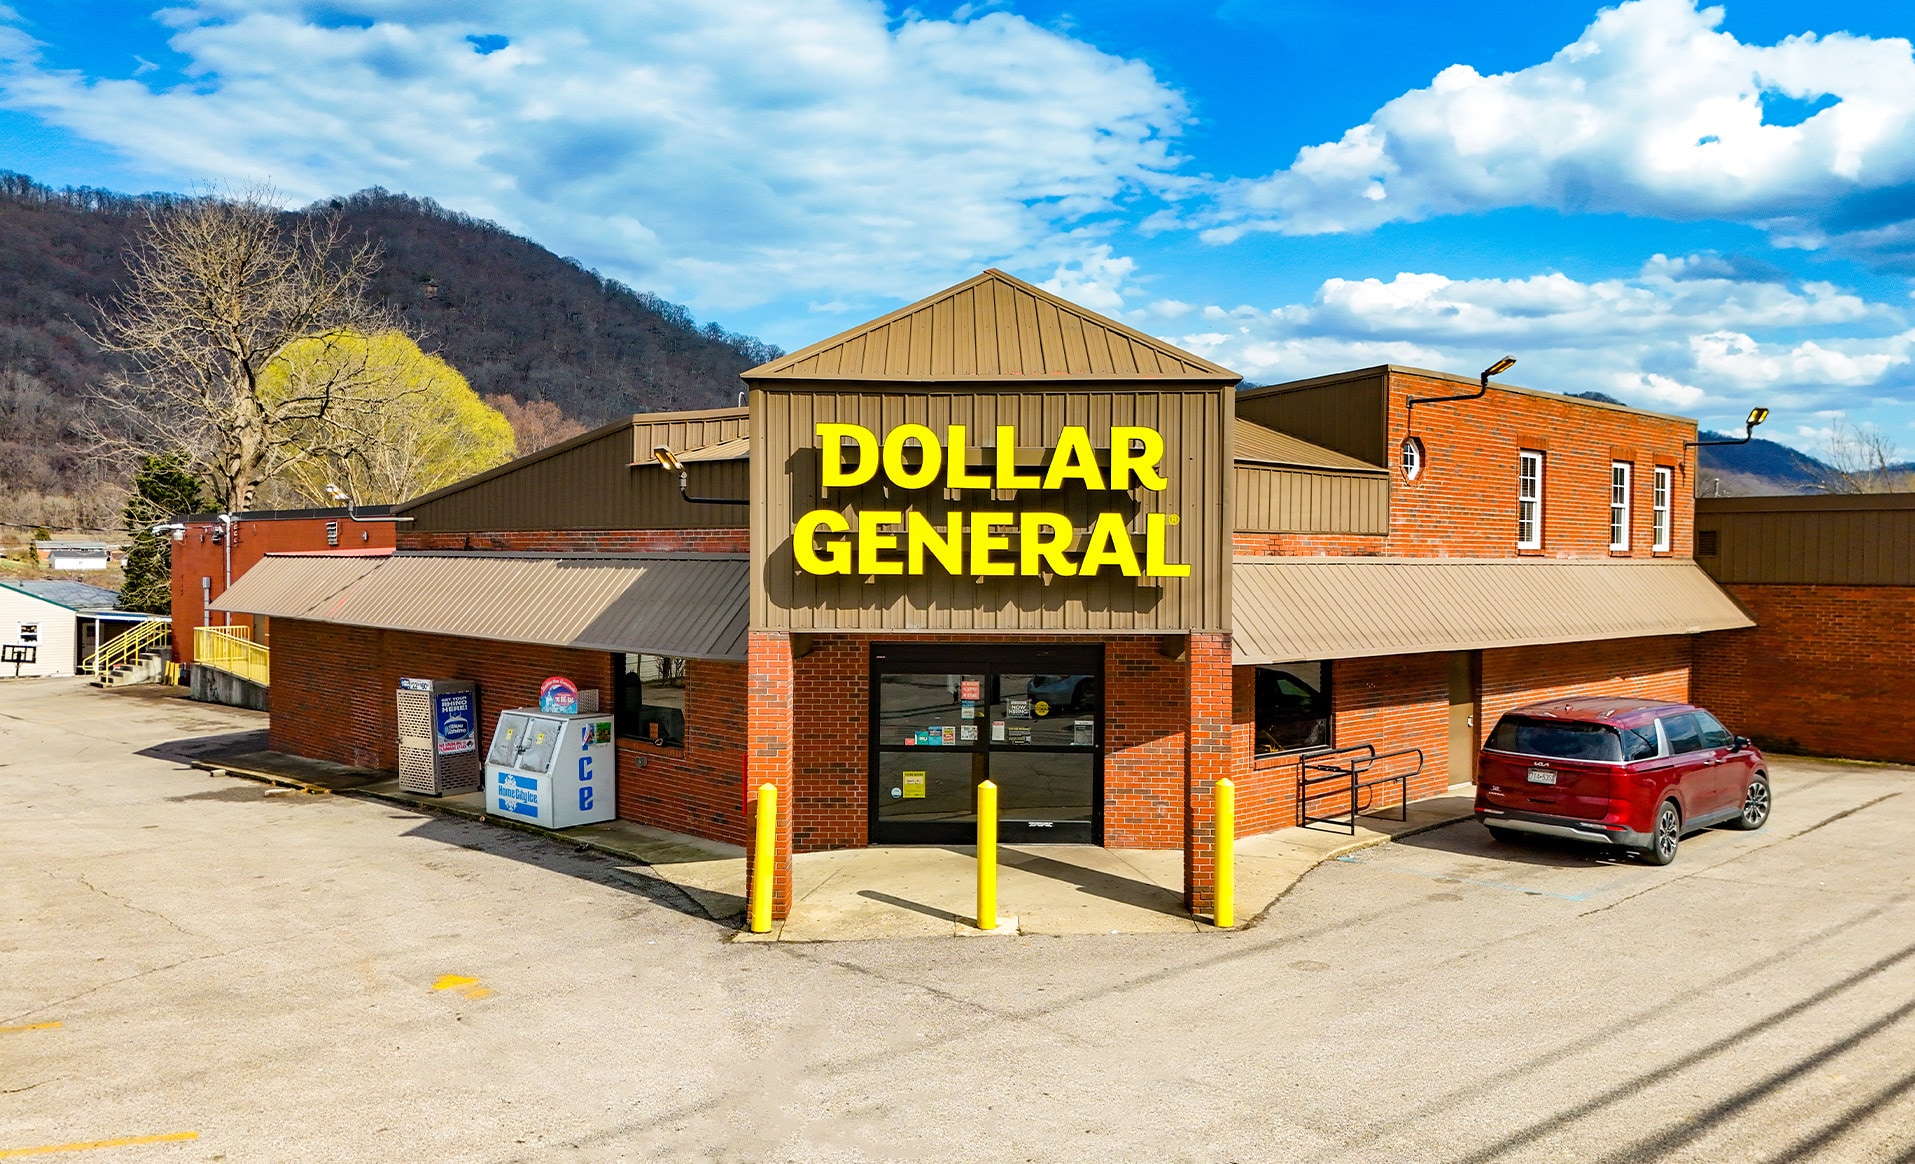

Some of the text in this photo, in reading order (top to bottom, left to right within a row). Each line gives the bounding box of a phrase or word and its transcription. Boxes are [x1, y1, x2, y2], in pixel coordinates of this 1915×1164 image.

[816, 423, 1168, 491] DOLLAR
[793, 510, 1191, 577] GENERAL
[442, 705, 468, 713] HERE!
[498, 785, 538, 804] Home City Ice
